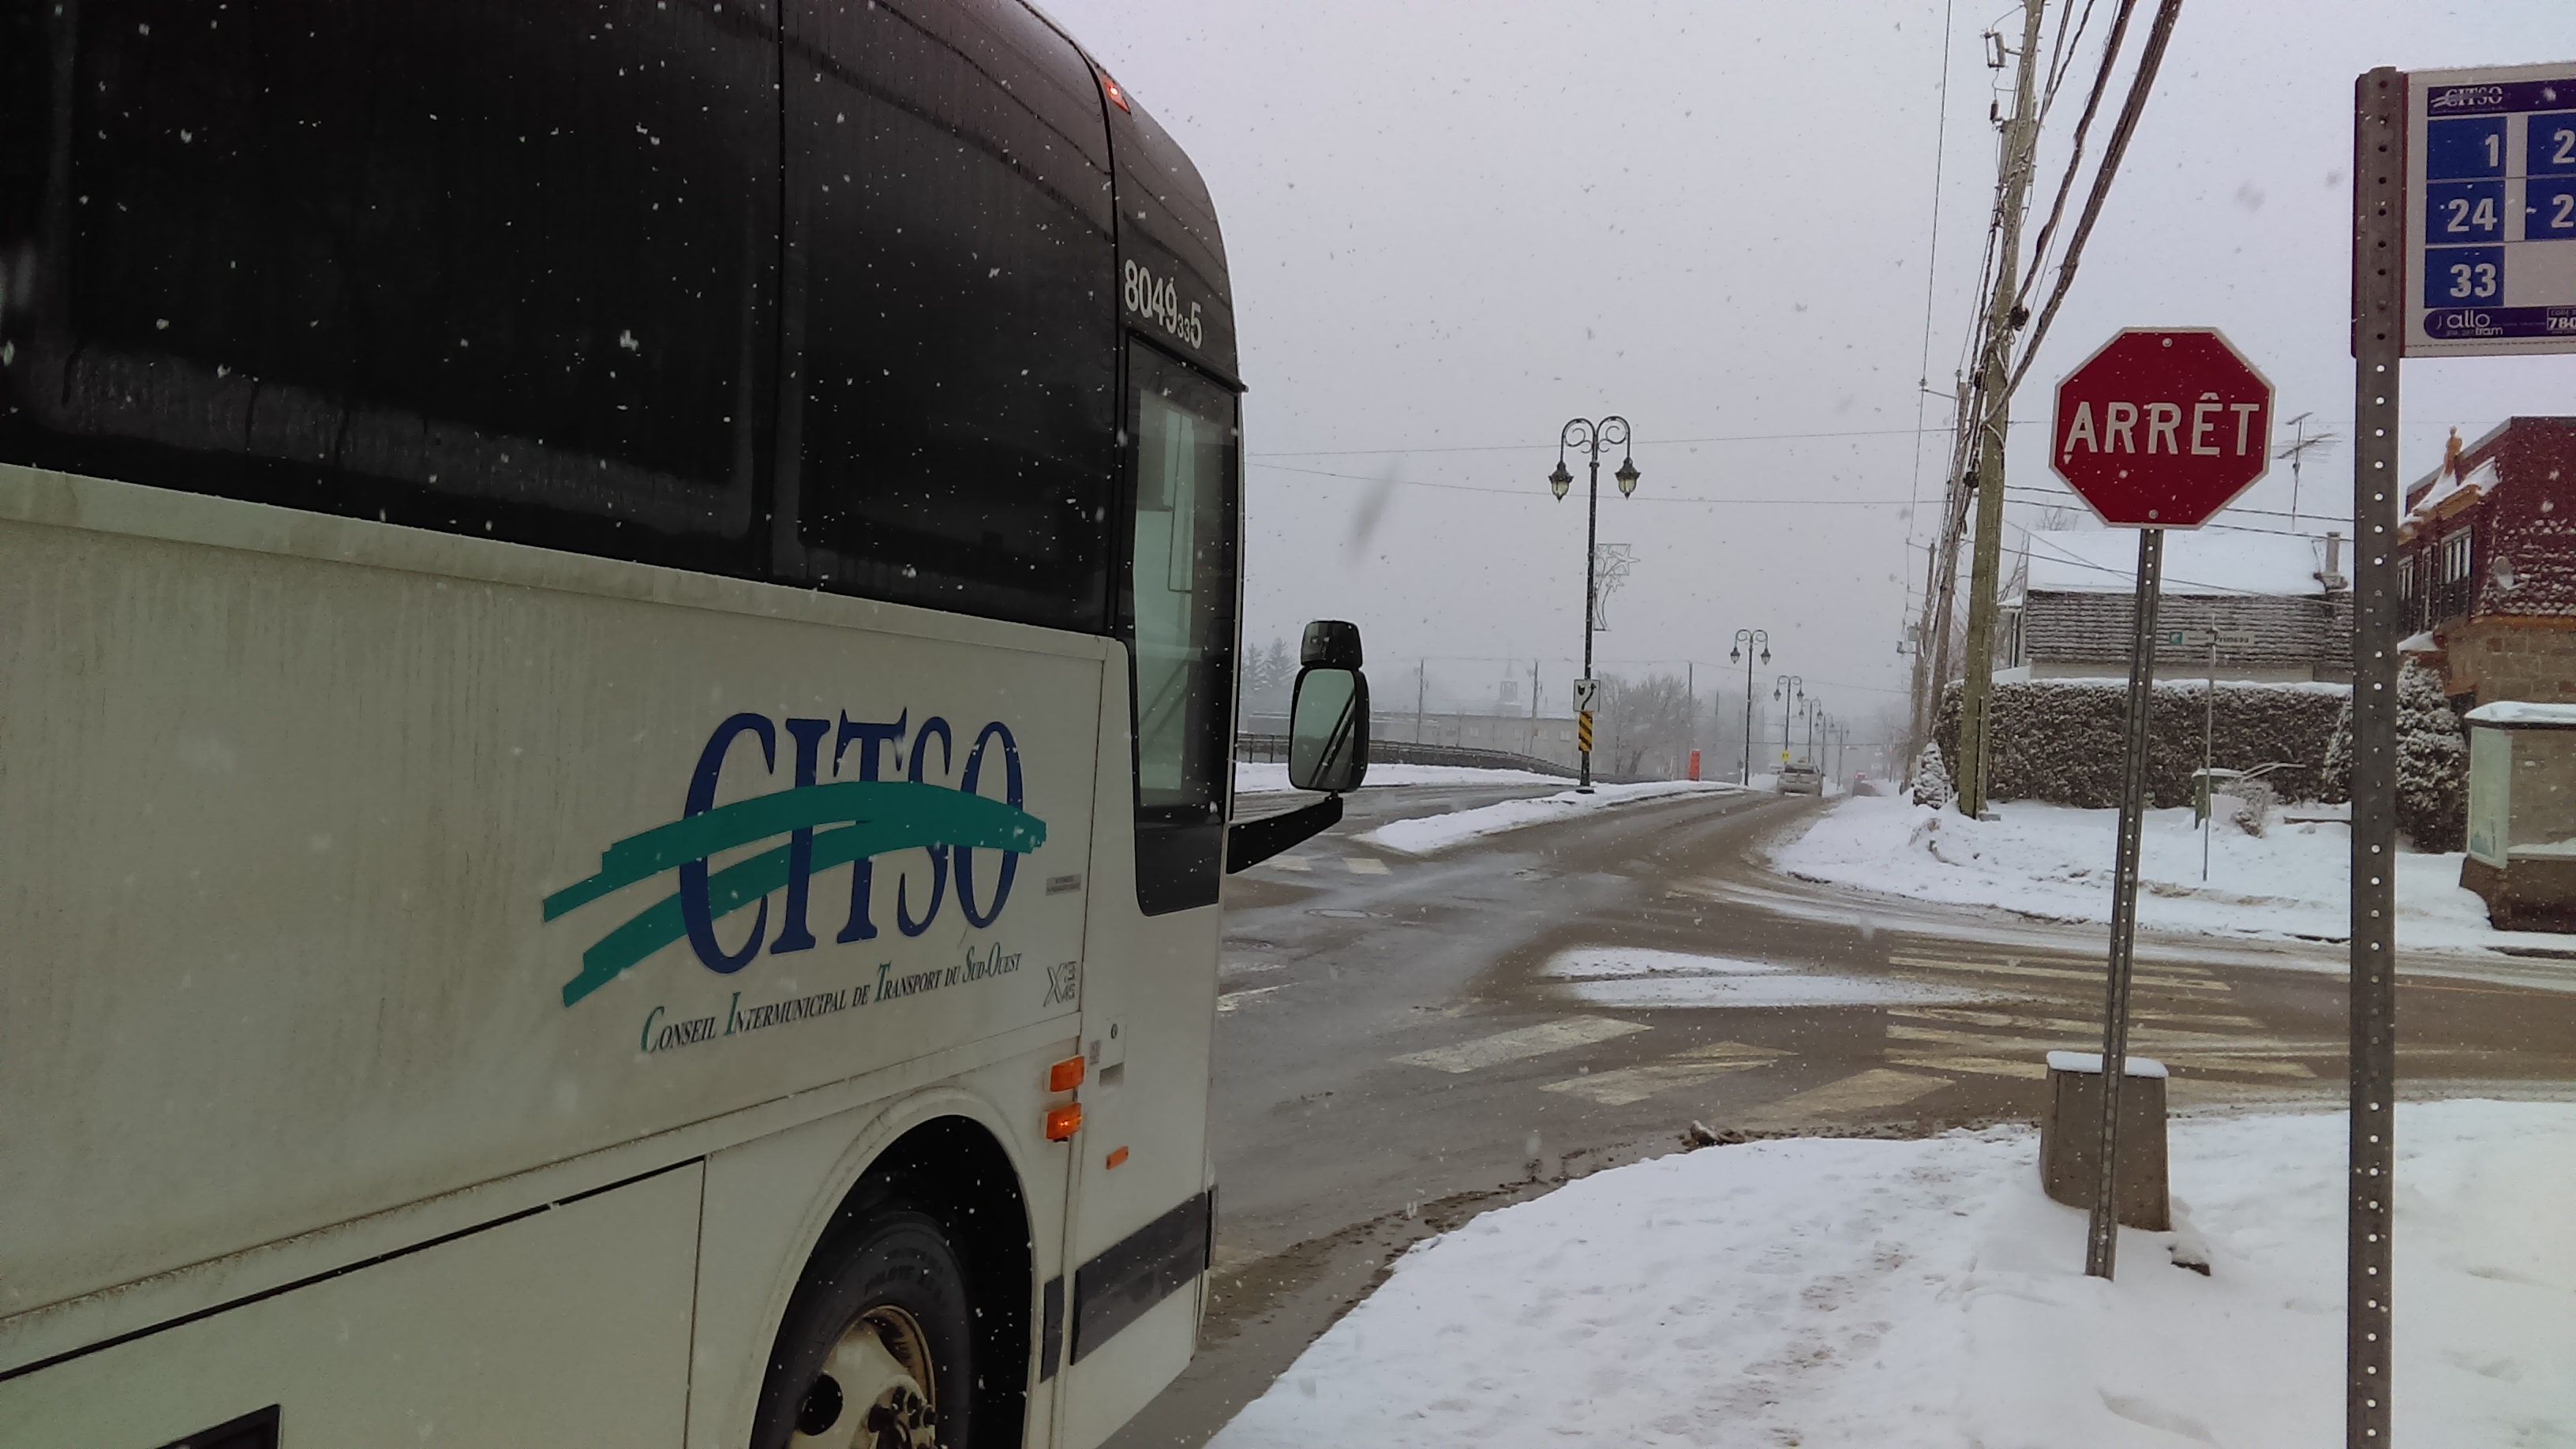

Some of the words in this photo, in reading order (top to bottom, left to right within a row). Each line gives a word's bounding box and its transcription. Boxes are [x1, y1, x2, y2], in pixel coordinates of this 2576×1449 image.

[2445, 86, 2503, 107] CITSO
[2484, 133, 2499, 167] 1
[2447, 198, 2498, 233] 24
[2449, 263, 2497, 298] 33
[2447, 309, 2490, 328] allo
[2475, 326, 2503, 336] tram
[2064, 392, 2260, 456] ARRÊT
[680, 707, 1023, 975] CITSO
[852, 984, 871, 1007] DE
[944, 965, 961, 987] DU
